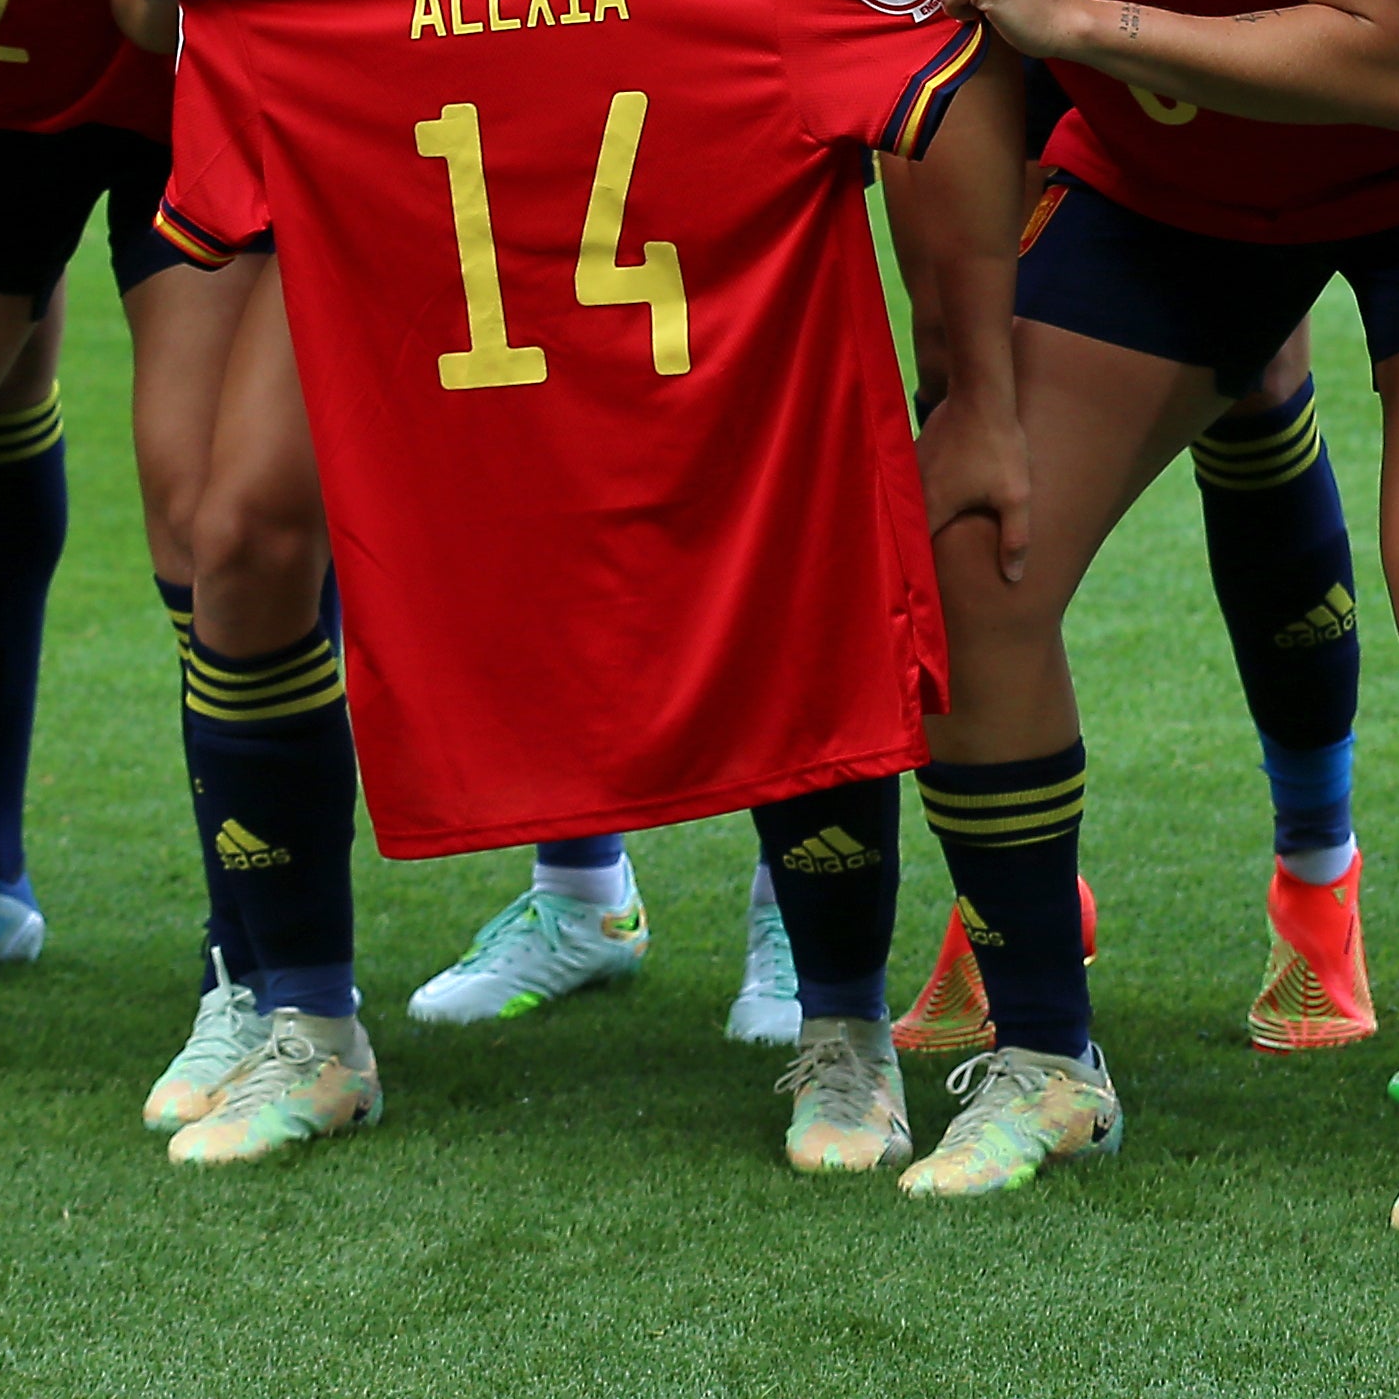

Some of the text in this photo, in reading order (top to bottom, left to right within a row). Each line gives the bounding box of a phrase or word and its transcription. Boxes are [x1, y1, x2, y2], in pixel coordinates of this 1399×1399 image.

[413, 91, 691, 390] 14
[1274, 611, 1356, 648] adida
[783, 849, 881, 874] adidas
